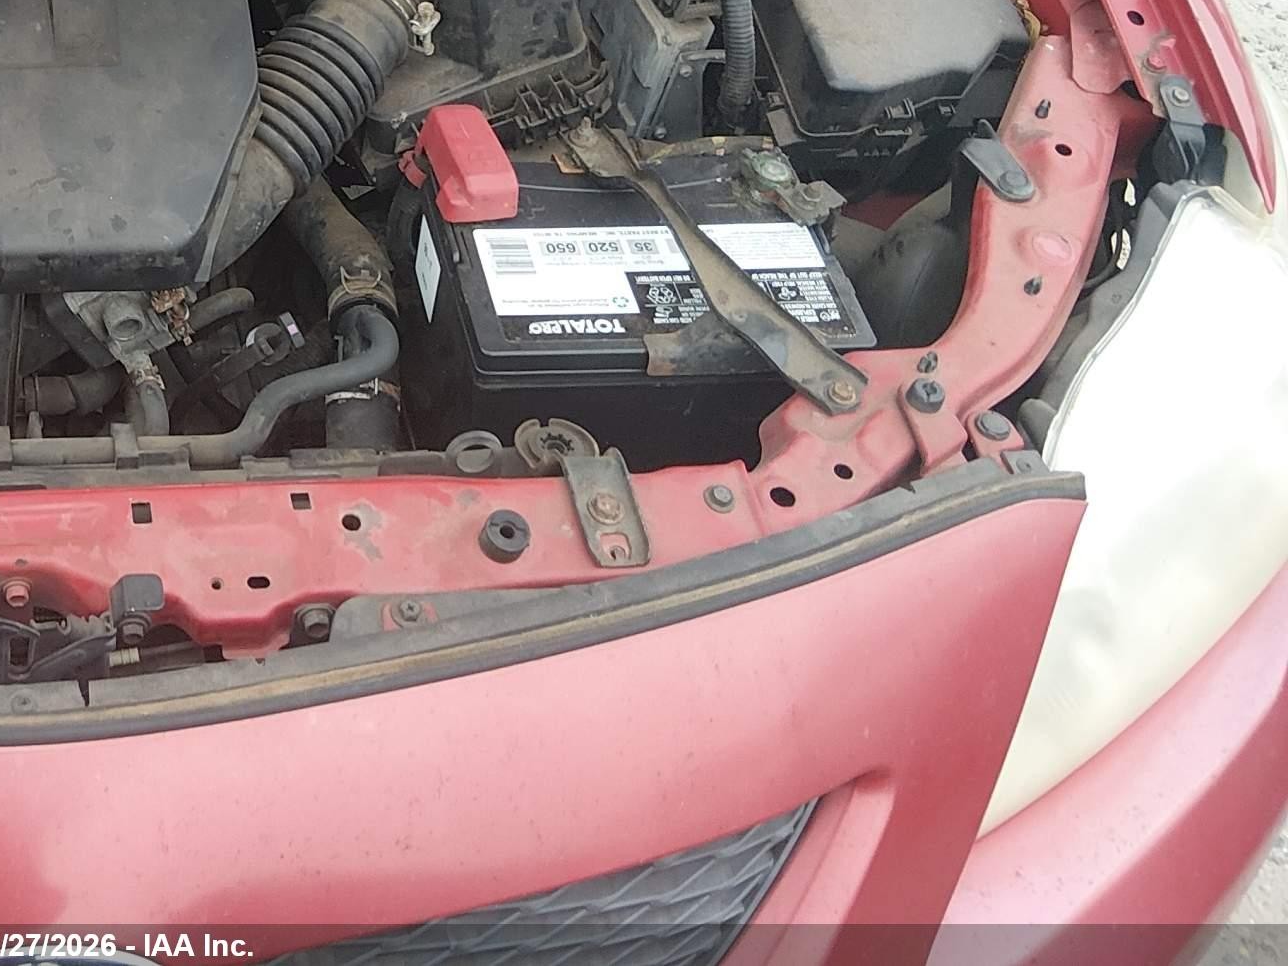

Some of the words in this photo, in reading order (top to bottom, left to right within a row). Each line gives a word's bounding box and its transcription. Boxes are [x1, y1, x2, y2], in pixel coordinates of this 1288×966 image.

[545, 242, 576, 254] 650
[588, 241, 619, 253] 520
[634, 241, 653, 252] 35
[528, 318, 626, 335] TOTALPRO
